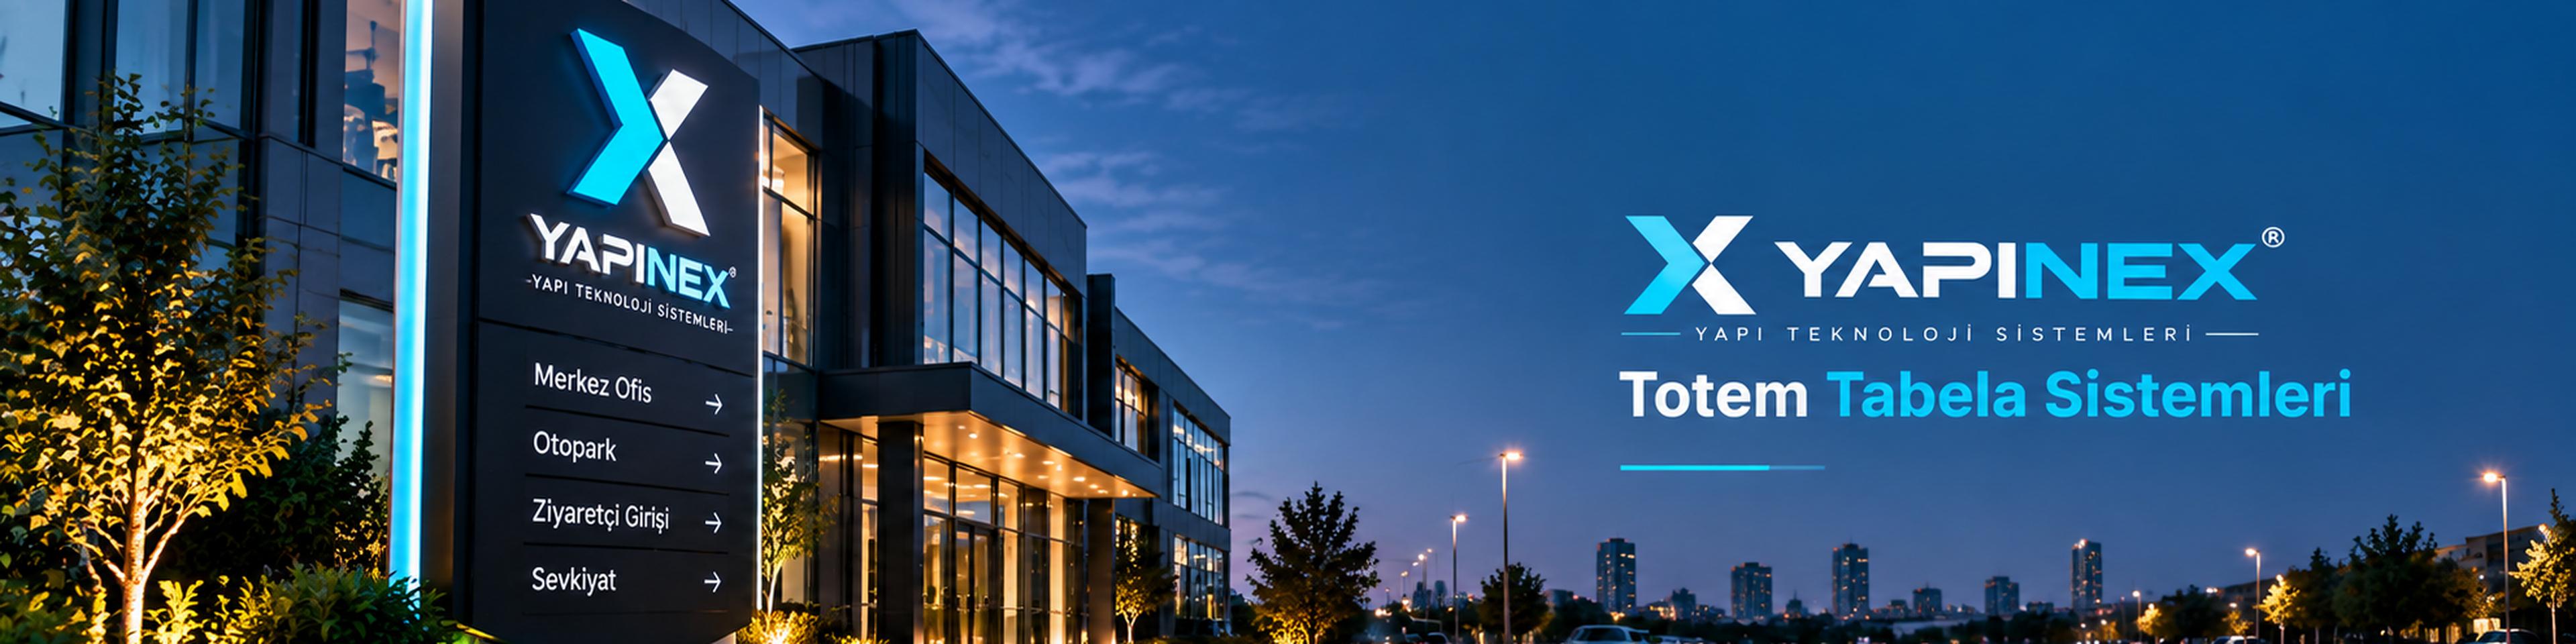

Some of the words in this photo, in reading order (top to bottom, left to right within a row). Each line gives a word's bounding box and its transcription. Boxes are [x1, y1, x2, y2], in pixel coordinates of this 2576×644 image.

[531, 274, 568, 295] YAPI
[575, 282, 652, 315] TEKNOLOJİ
[534, 362, 610, 397] Merkez
[614, 376, 653, 404] Ofis
[533, 430, 617, 463] Otopark
[532, 498, 620, 532] Ziyaretçi
[625, 504, 669, 535] Girişi
[531, 566, 617, 597] Sevkiyat
